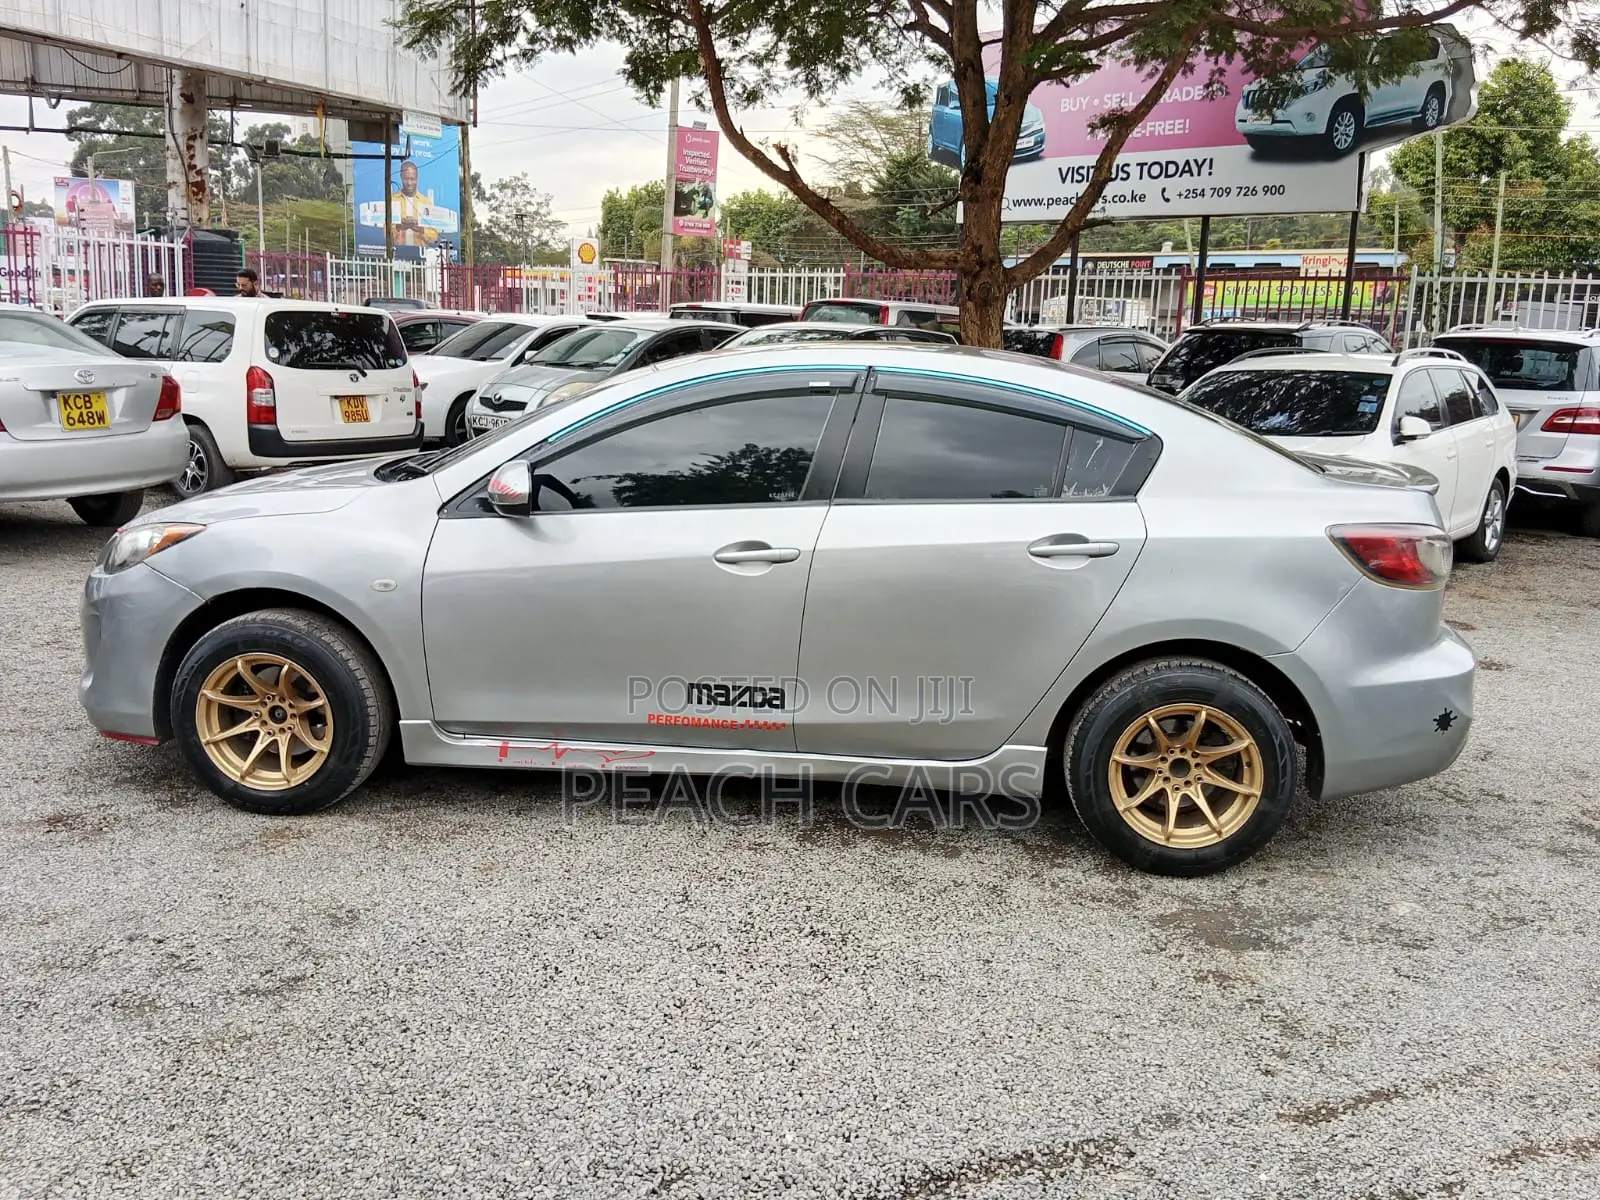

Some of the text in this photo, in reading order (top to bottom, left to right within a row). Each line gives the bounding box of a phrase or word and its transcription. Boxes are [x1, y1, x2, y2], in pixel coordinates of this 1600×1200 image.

[1060, 96, 1089, 113] BUY
[1103, 91, 1137, 109] SELL
[1136, 158, 1214, 180] TODAY!
[1176, 188, 1206, 200] +254
[1210, 186, 1232, 198] 709
[1236, 185, 1258, 197] 726
[1262, 184, 1286, 196] 900
[1097, 260, 1151, 269] DEUTSCHE POINT
[1225, 285, 1272, 297] SHIZNIT
[1275, 285, 1333, 297] SPOTLESS
[1337, 286, 1359, 296] SA
[62, 394, 93, 411] KCB
[346, 397, 364, 409] KDV
[66, 410, 105, 427] 648W
[344, 410, 369, 422] 985U
[647, 713, 739, 731] PERFOMANCE
